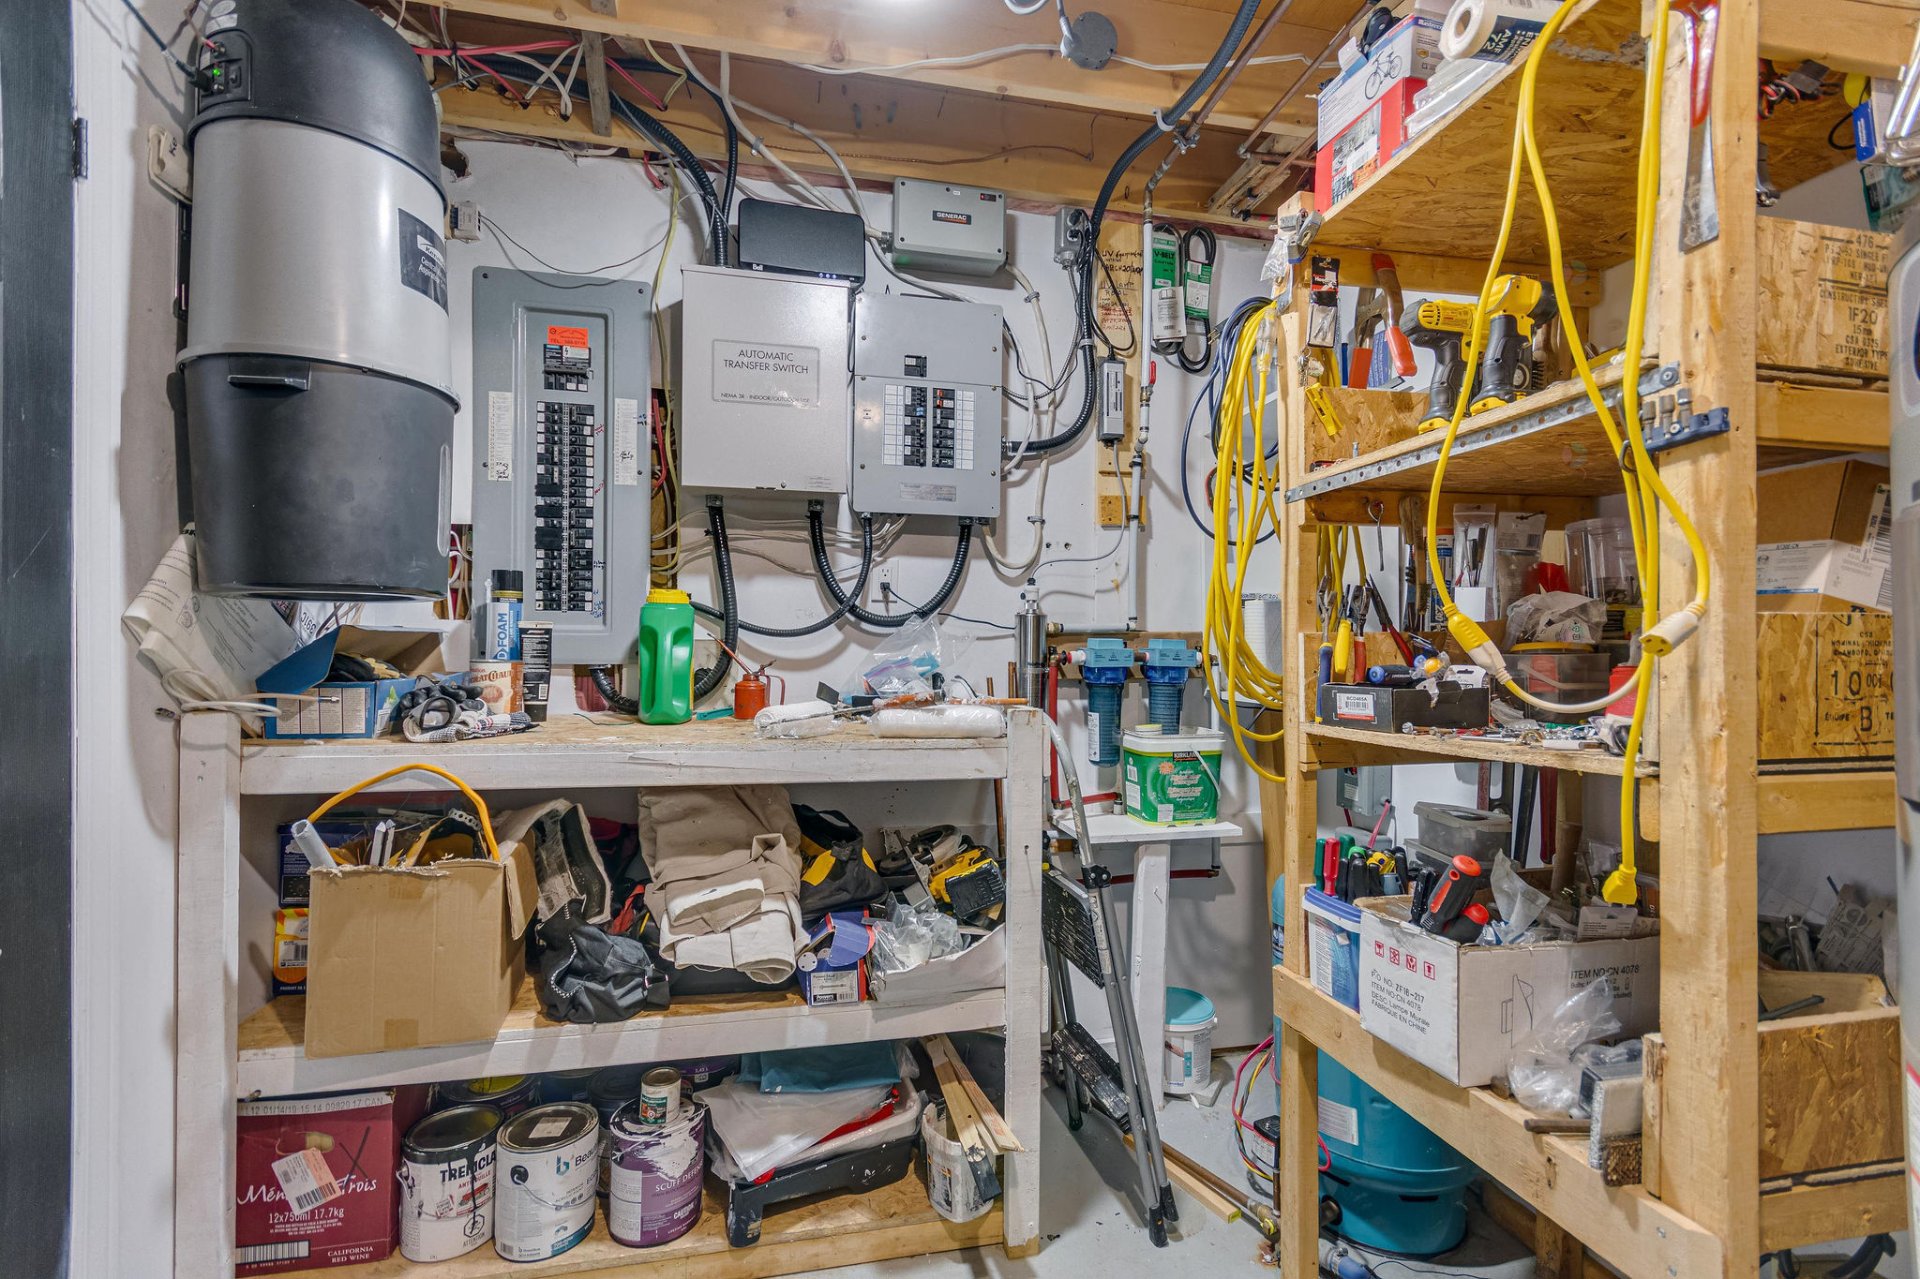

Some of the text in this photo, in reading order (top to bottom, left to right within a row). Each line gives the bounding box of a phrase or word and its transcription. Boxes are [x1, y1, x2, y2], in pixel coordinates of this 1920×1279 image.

[936, 212, 967, 220] GENERAC
[1154, 250, 1174, 259] V-BELT
[738, 349, 794, 361] AUTOMATIC
[1835, 344, 1868, 358] EXTERIOR
[724, 359, 808, 374] TRANSFER SWITCH
[497, 613, 507, 647] FOAM
[1860, 706, 1872, 732] B
[1571, 969, 1591, 979] ITEM
[1620, 964, 1640, 974] 4078
[1371, 981, 1384, 993] ITEM
[1407, 1000, 1421, 1011] 4078
[1371, 999, 1398, 1019] FABRIQUE
[1408, 1020, 1427, 1034] CHINE
[364, 1097, 384, 1106] CAN
[237, 1174, 377, 1205] Mén Trois
[655, 1178, 681, 1192] SCUFF
[269, 1207, 345, 1224] 12x750ml 17.7kg
[327, 1246, 374, 1257] CALIFORNIA
[331, 1253, 370, 1263] RED WINE
